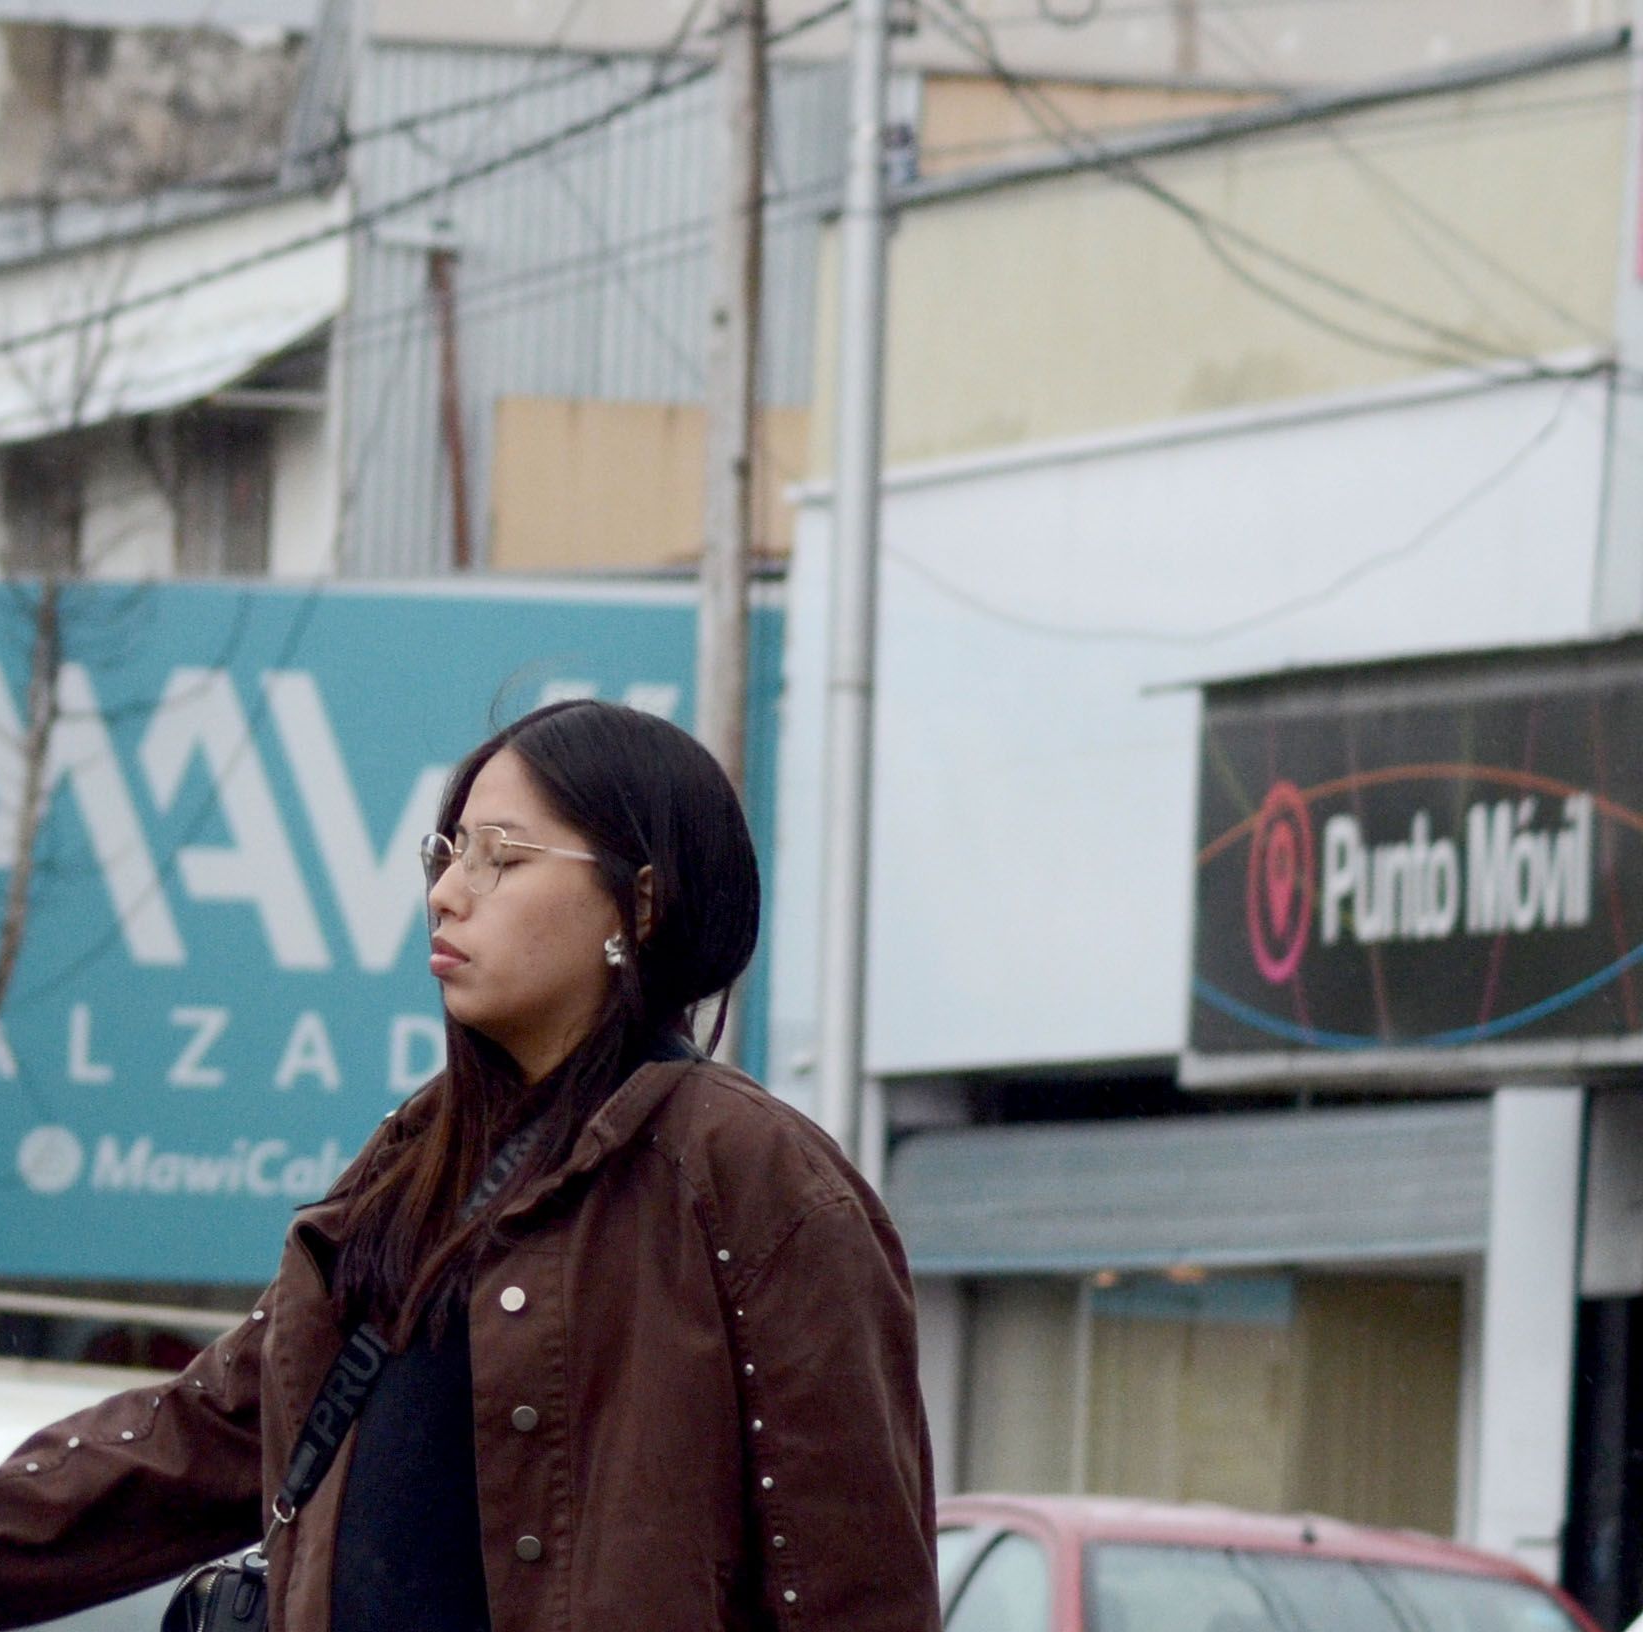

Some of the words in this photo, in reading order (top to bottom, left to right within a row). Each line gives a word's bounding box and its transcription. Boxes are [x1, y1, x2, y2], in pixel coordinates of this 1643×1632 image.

[1323, 811, 1459, 946] Punto
[1467, 792, 1591, 935] Móvil
[93, 1134, 357, 1195] MawiCal
